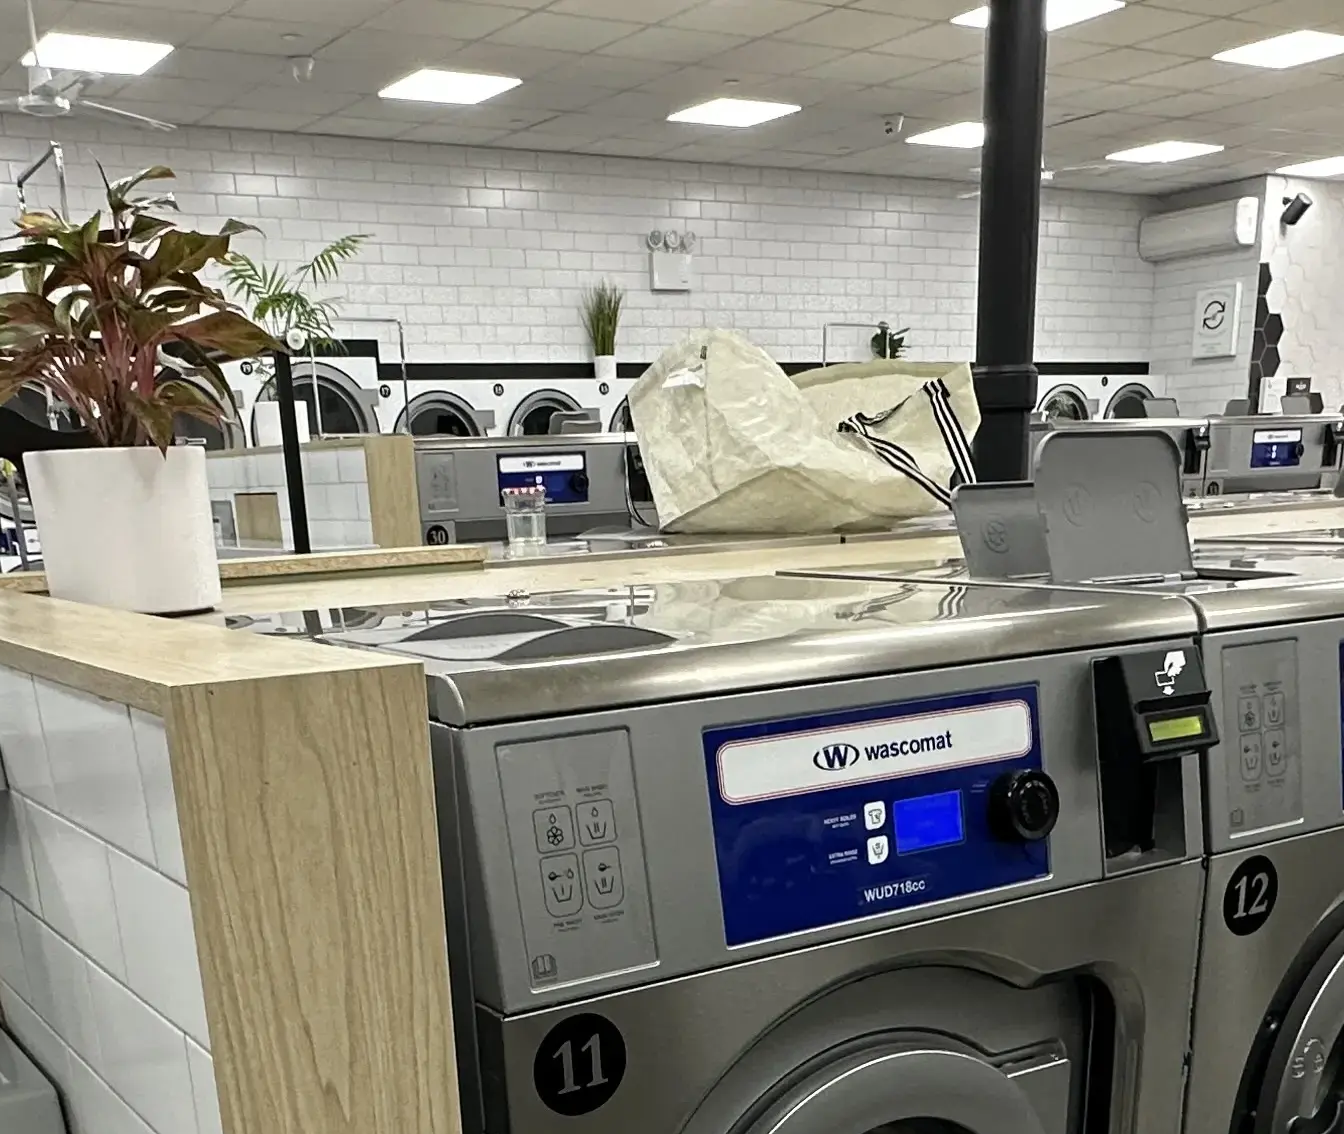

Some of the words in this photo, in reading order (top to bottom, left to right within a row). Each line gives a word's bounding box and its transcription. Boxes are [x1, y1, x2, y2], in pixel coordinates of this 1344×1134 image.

[429, 529, 447, 545] 30
[864, 730, 953, 762] wascomat
[863, 880, 927, 903] WUD718cc
[1231, 872, 1271, 920] 12
[553, 1032, 609, 1097] 11
